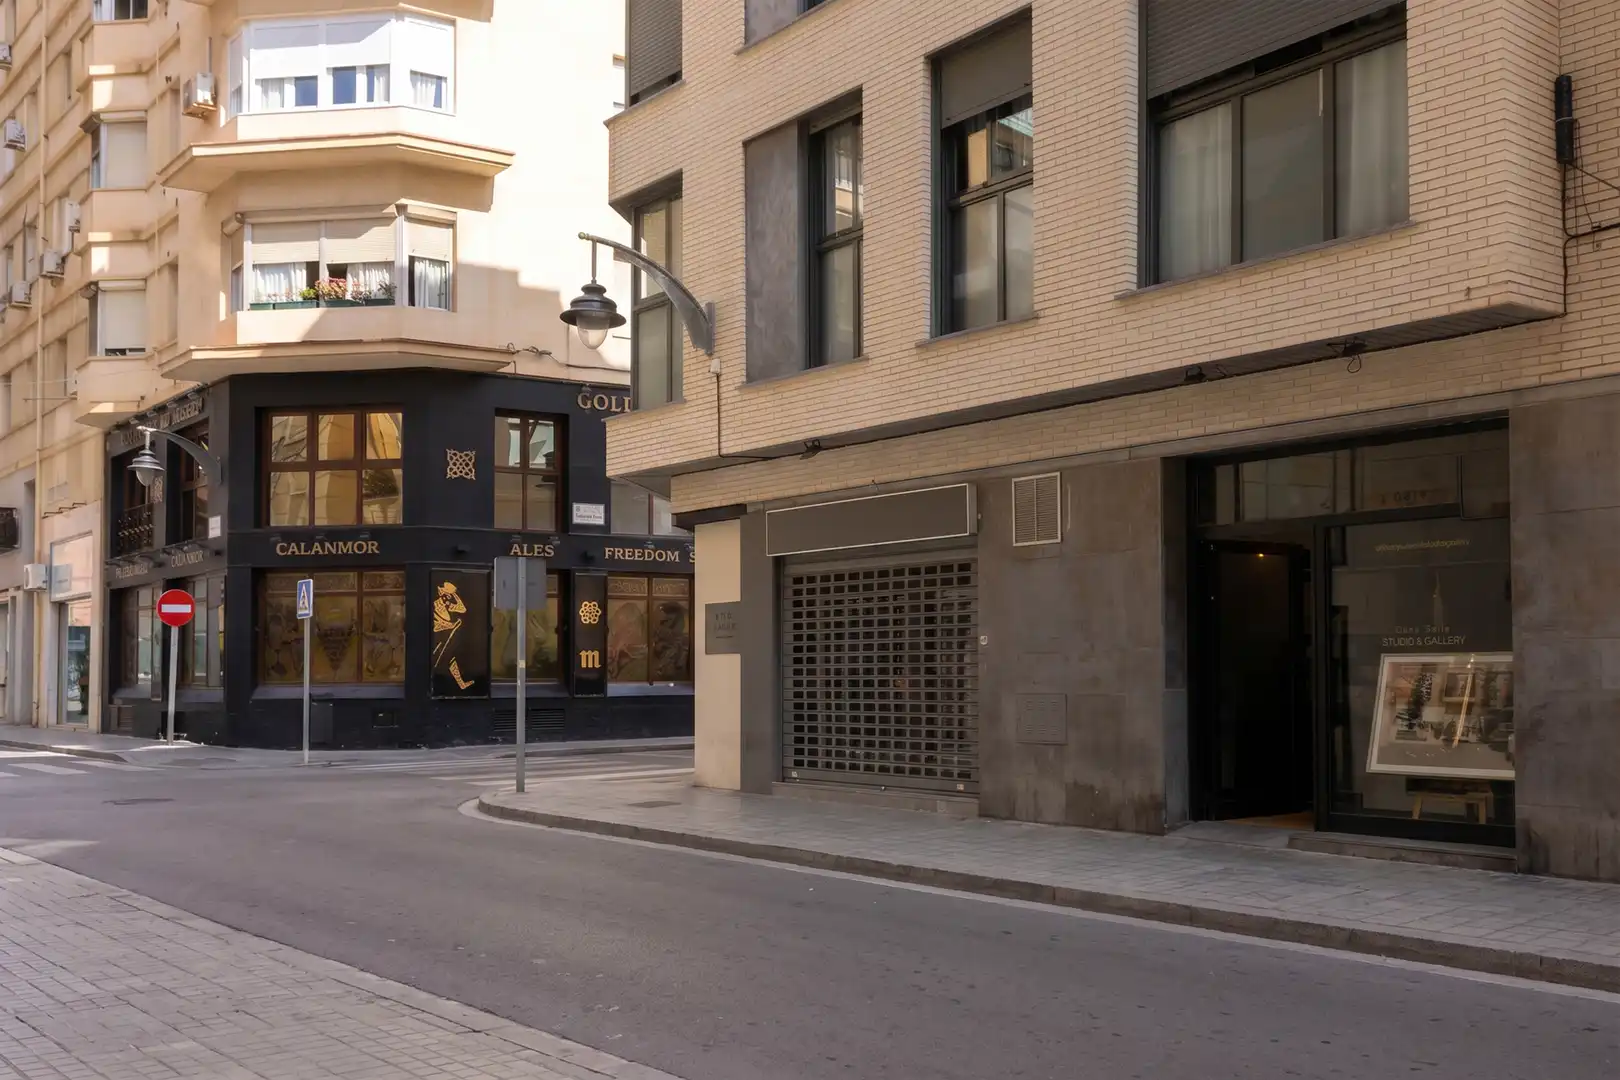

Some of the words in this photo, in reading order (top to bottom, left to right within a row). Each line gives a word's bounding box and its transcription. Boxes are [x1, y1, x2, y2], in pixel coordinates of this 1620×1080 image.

[276, 541, 380, 556] CALANMOR
[510, 543, 555, 557] ALES
[604, 547, 680, 563] FREEDOM
[1382, 637, 1415, 647] STUDIO
[1424, 635, 1466, 646] GALLERY
